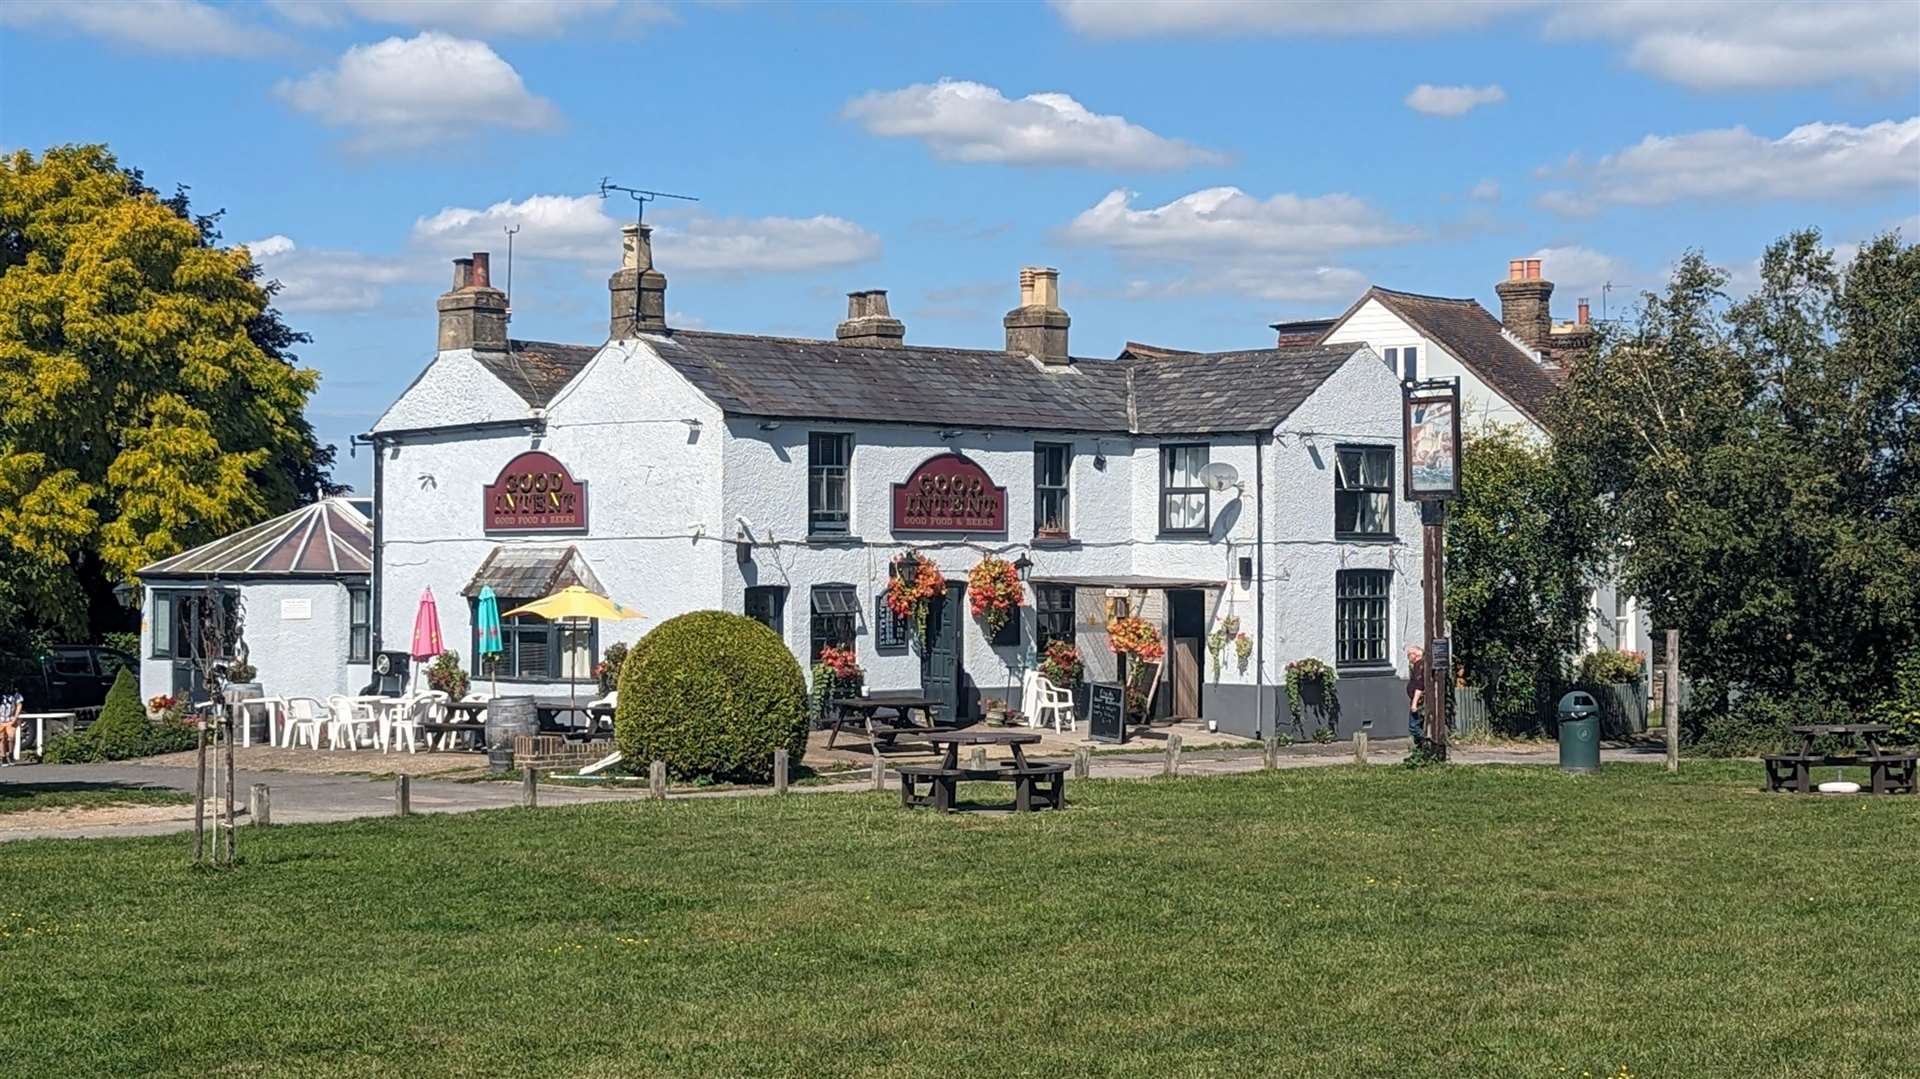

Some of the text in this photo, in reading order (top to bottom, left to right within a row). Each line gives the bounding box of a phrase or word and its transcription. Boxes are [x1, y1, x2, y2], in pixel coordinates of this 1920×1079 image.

[505, 473, 563, 494] GOOD
[918, 473, 984, 497] GOOD
[494, 491, 576, 514] INTENT
[905, 493, 998, 518] INTENT
[494, 516, 515, 525] GOOD
[518, 516, 538, 525] FOOD
[903, 516, 927, 526] GOOD
[930, 516, 953, 526] FOOD
